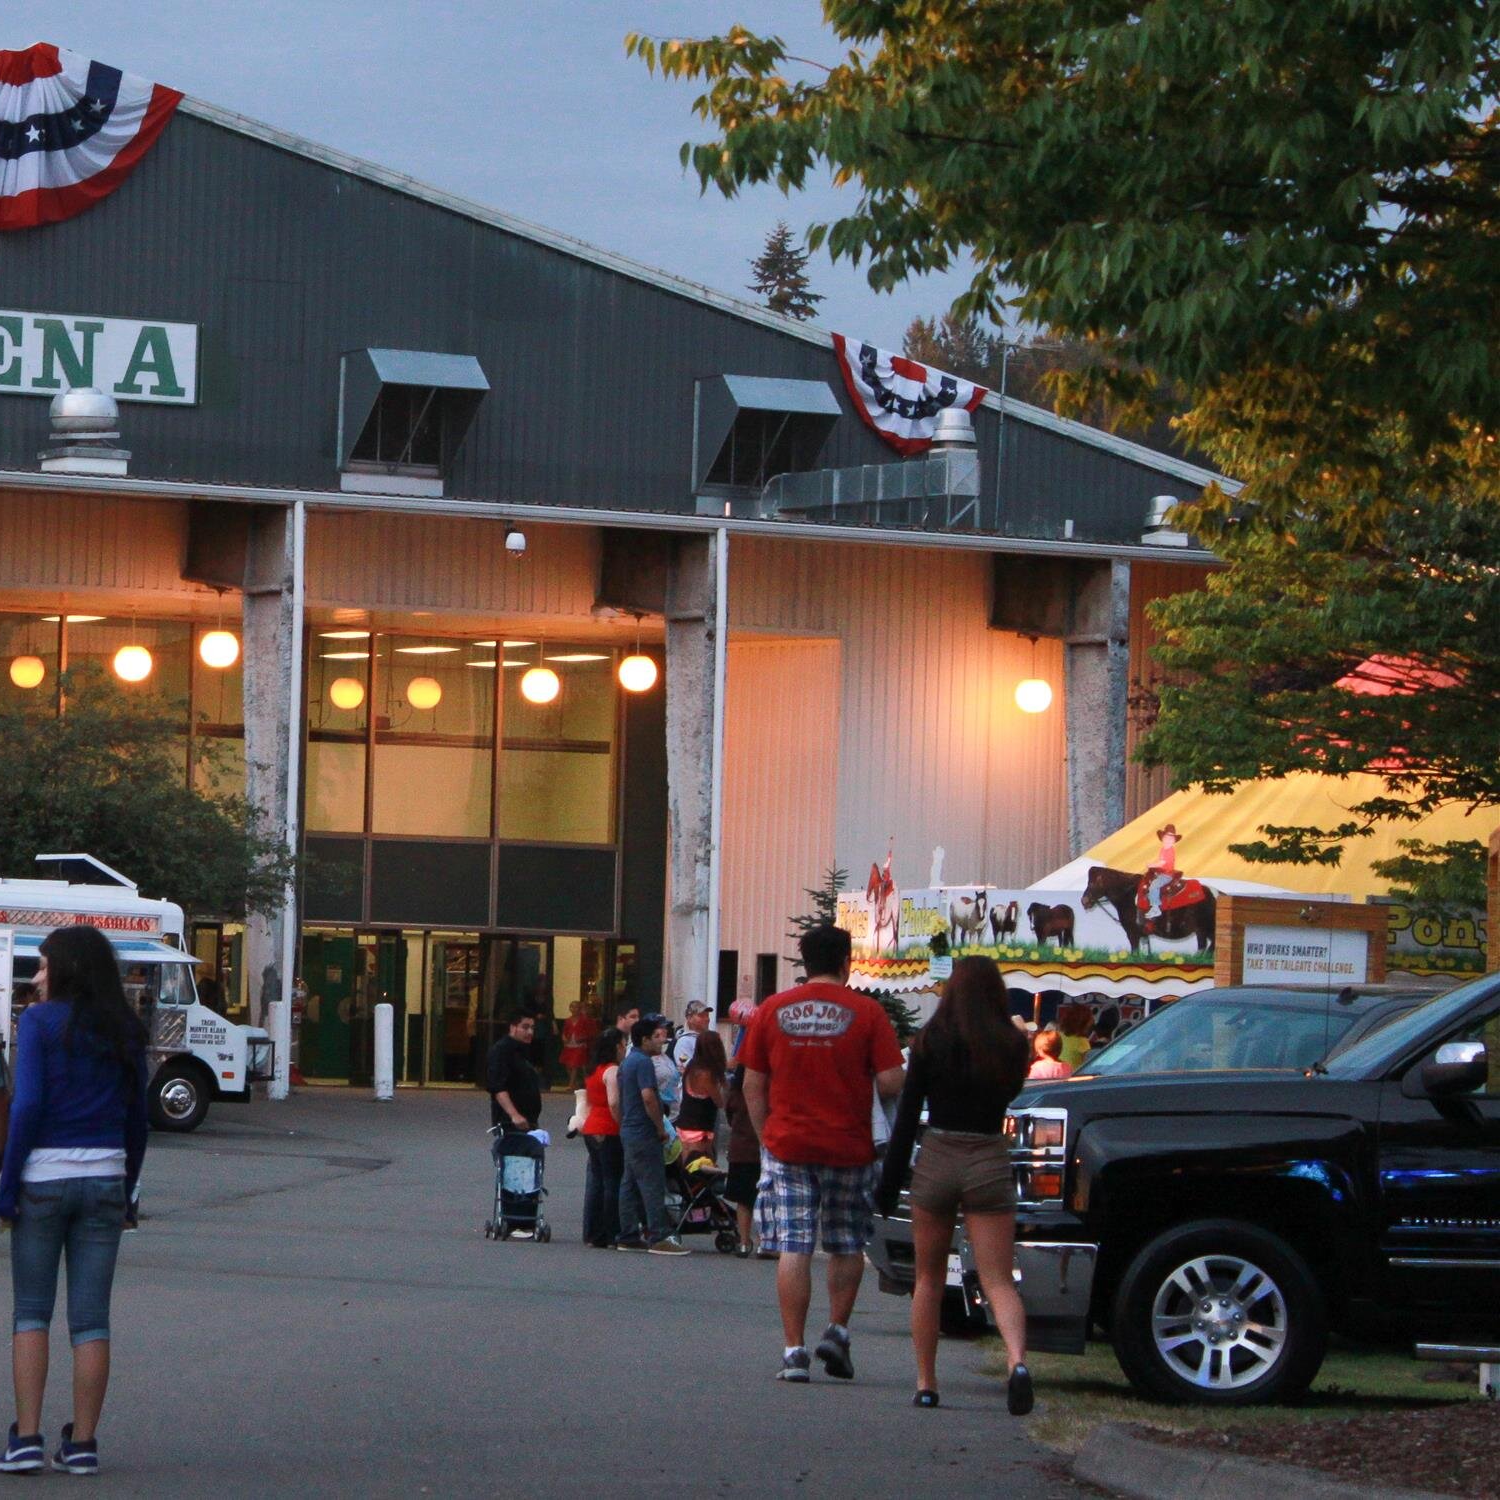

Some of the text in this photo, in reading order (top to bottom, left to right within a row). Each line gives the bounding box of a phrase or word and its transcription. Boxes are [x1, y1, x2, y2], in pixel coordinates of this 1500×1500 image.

[1247, 943, 1328, 958] WHO WORKS SMARTER?
[1247, 959, 1264, 970] TAKE
[1266, 959, 1278, 970] THE
[1281, 960, 1311, 972] TAILGATE
[781, 1004, 852, 1024] RON JON
[788, 1022, 837, 1031] SURF SHOP
